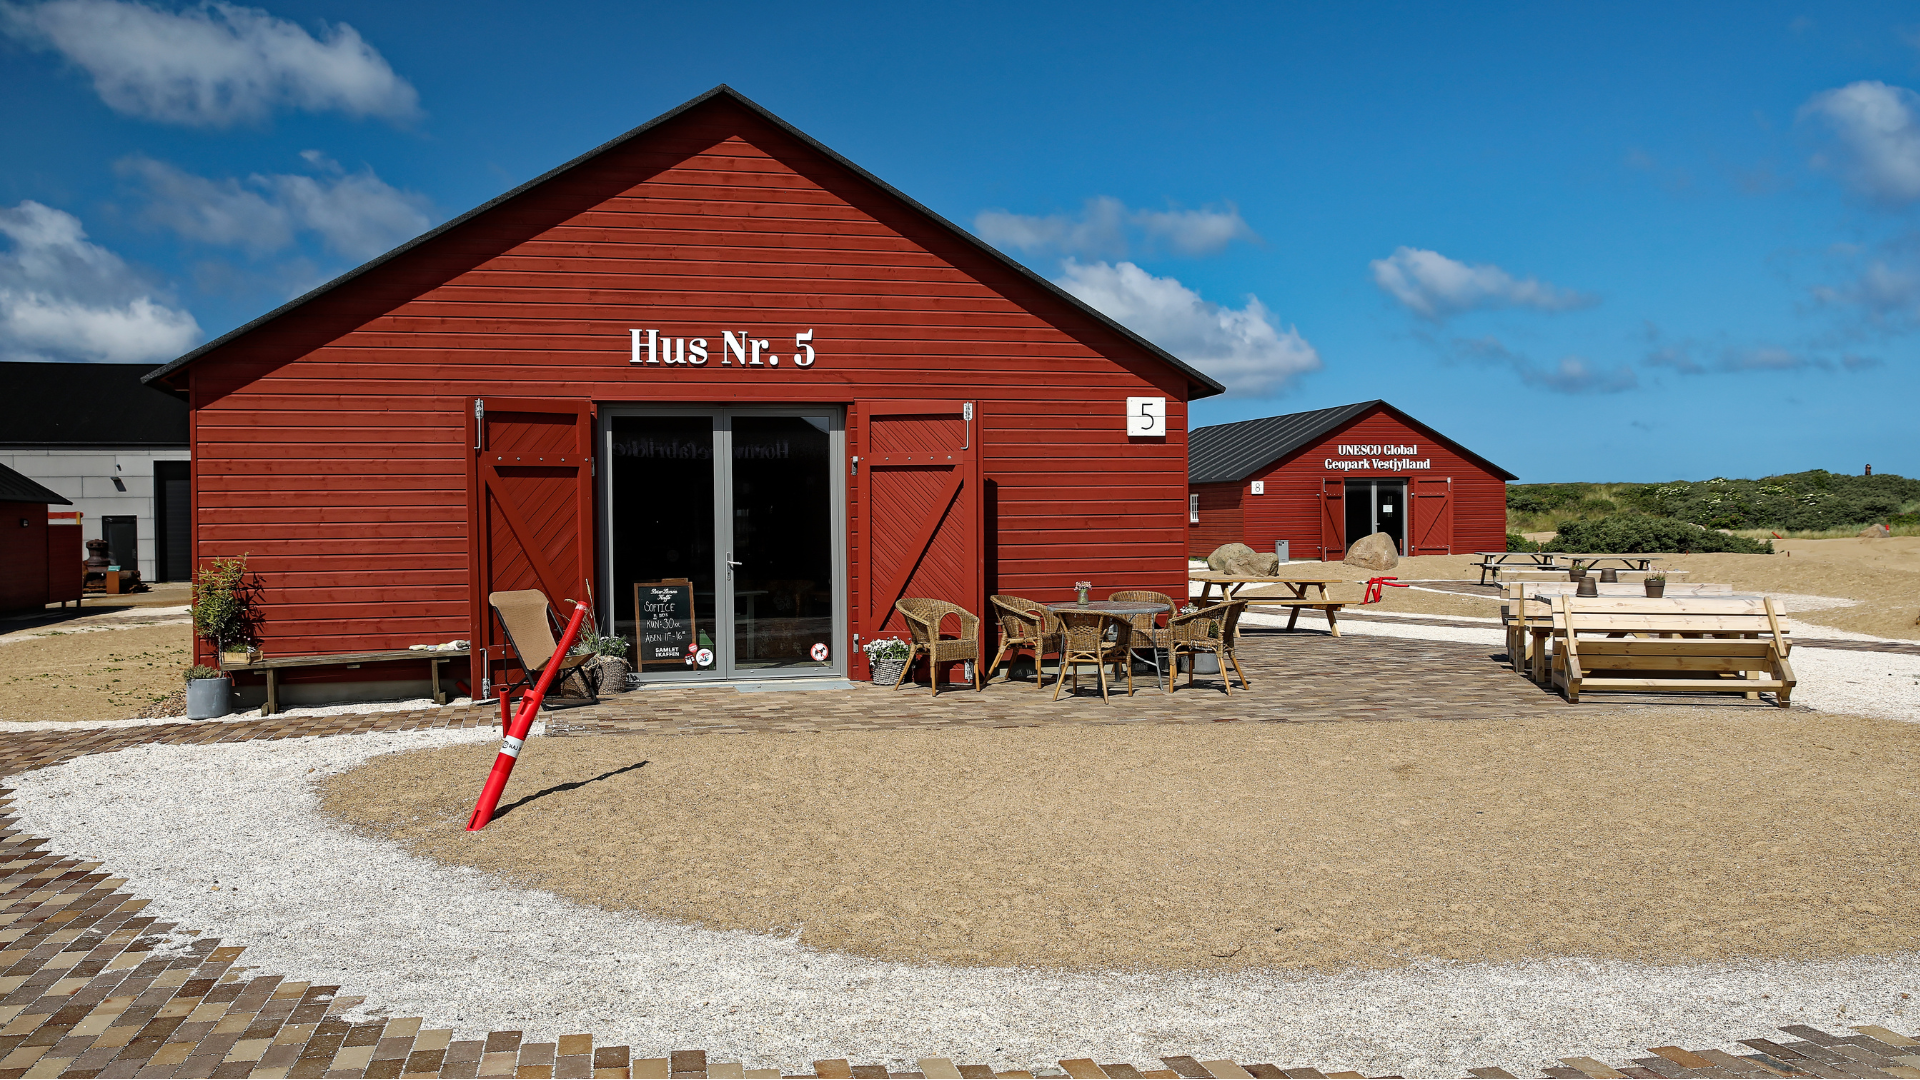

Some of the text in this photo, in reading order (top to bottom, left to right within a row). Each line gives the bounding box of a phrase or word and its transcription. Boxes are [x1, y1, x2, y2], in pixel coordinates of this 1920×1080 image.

[628, 328, 816, 367] Hus Nr. 5
[1140, 402, 1155, 431] 5
[1337, 444, 1418, 455] UNESCO Global
[1324, 458, 1431, 472] Geopark Vestjylland
[1254, 482, 1261, 493] 8
